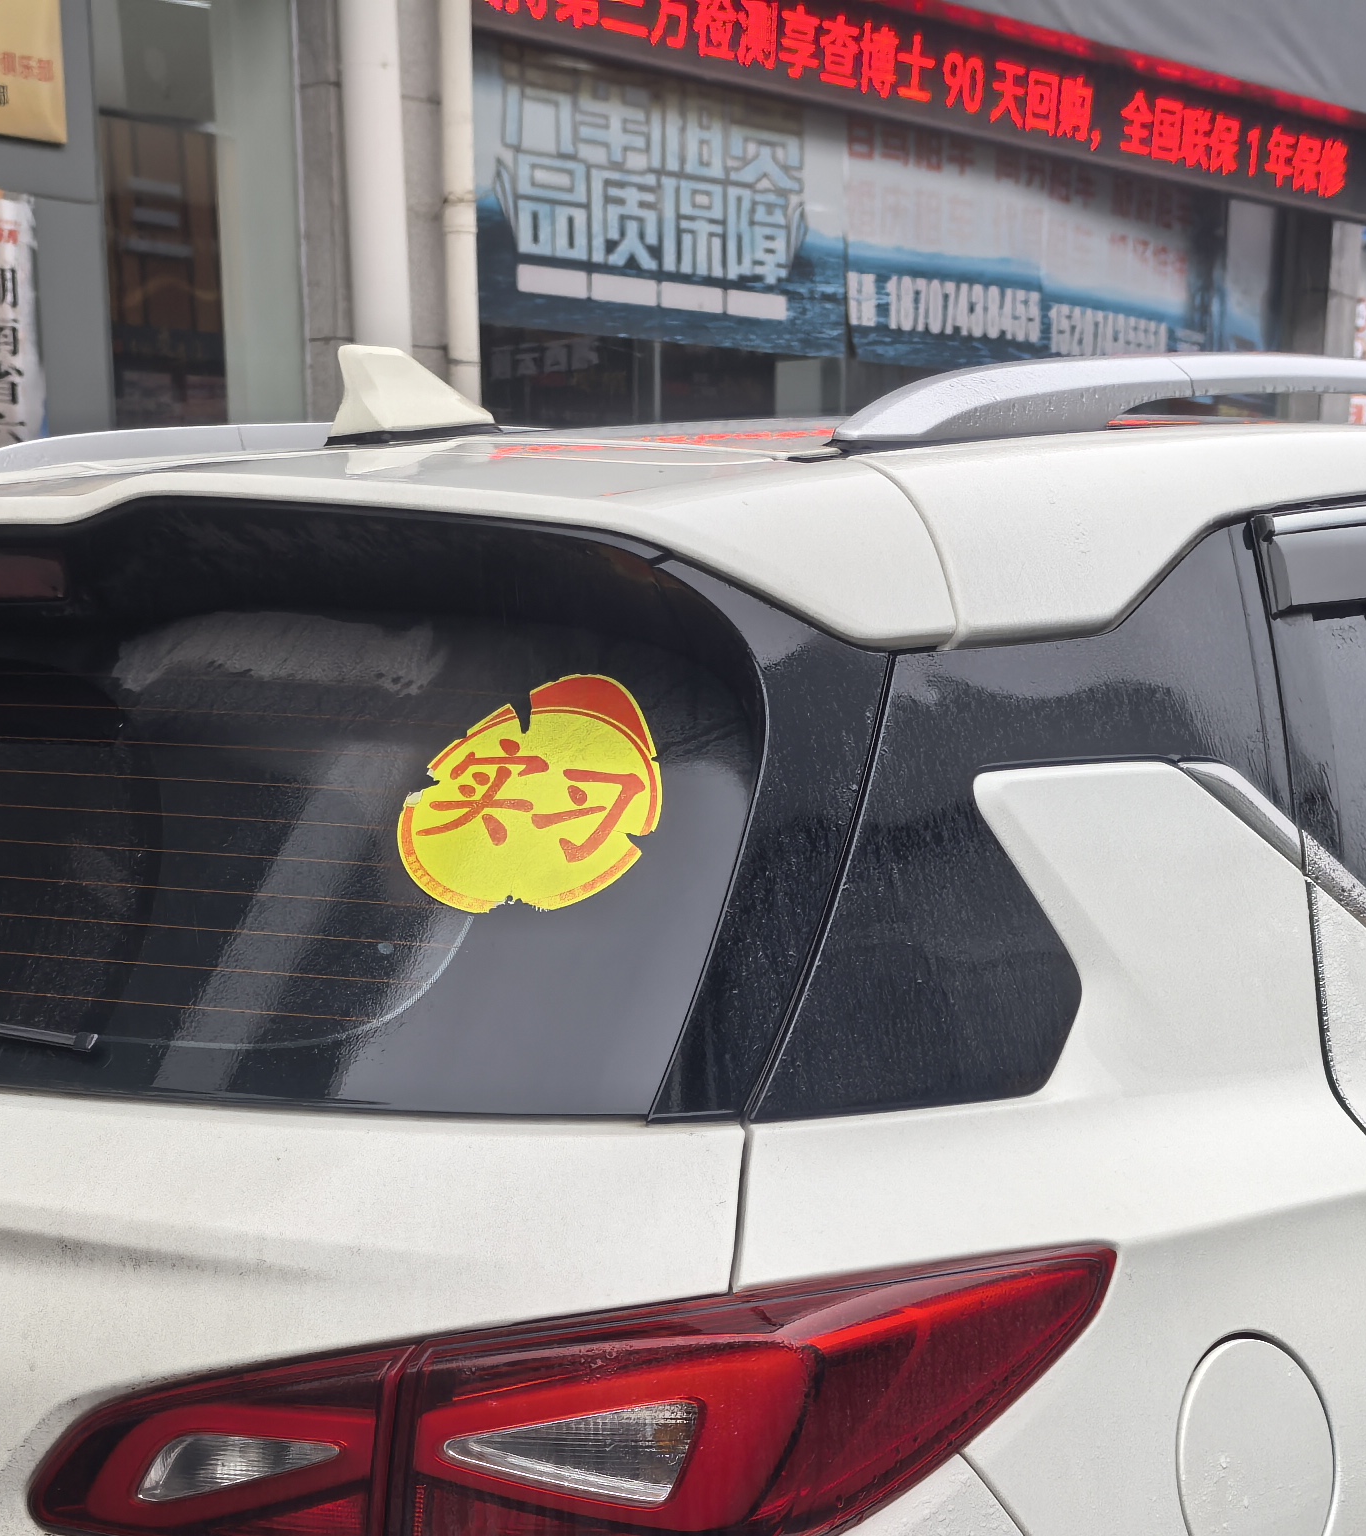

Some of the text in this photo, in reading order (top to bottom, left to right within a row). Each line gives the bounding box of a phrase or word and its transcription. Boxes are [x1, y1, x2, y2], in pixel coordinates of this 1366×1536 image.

[516, 150, 789, 285] 品质保障
[415, 738, 646, 863] 实习
